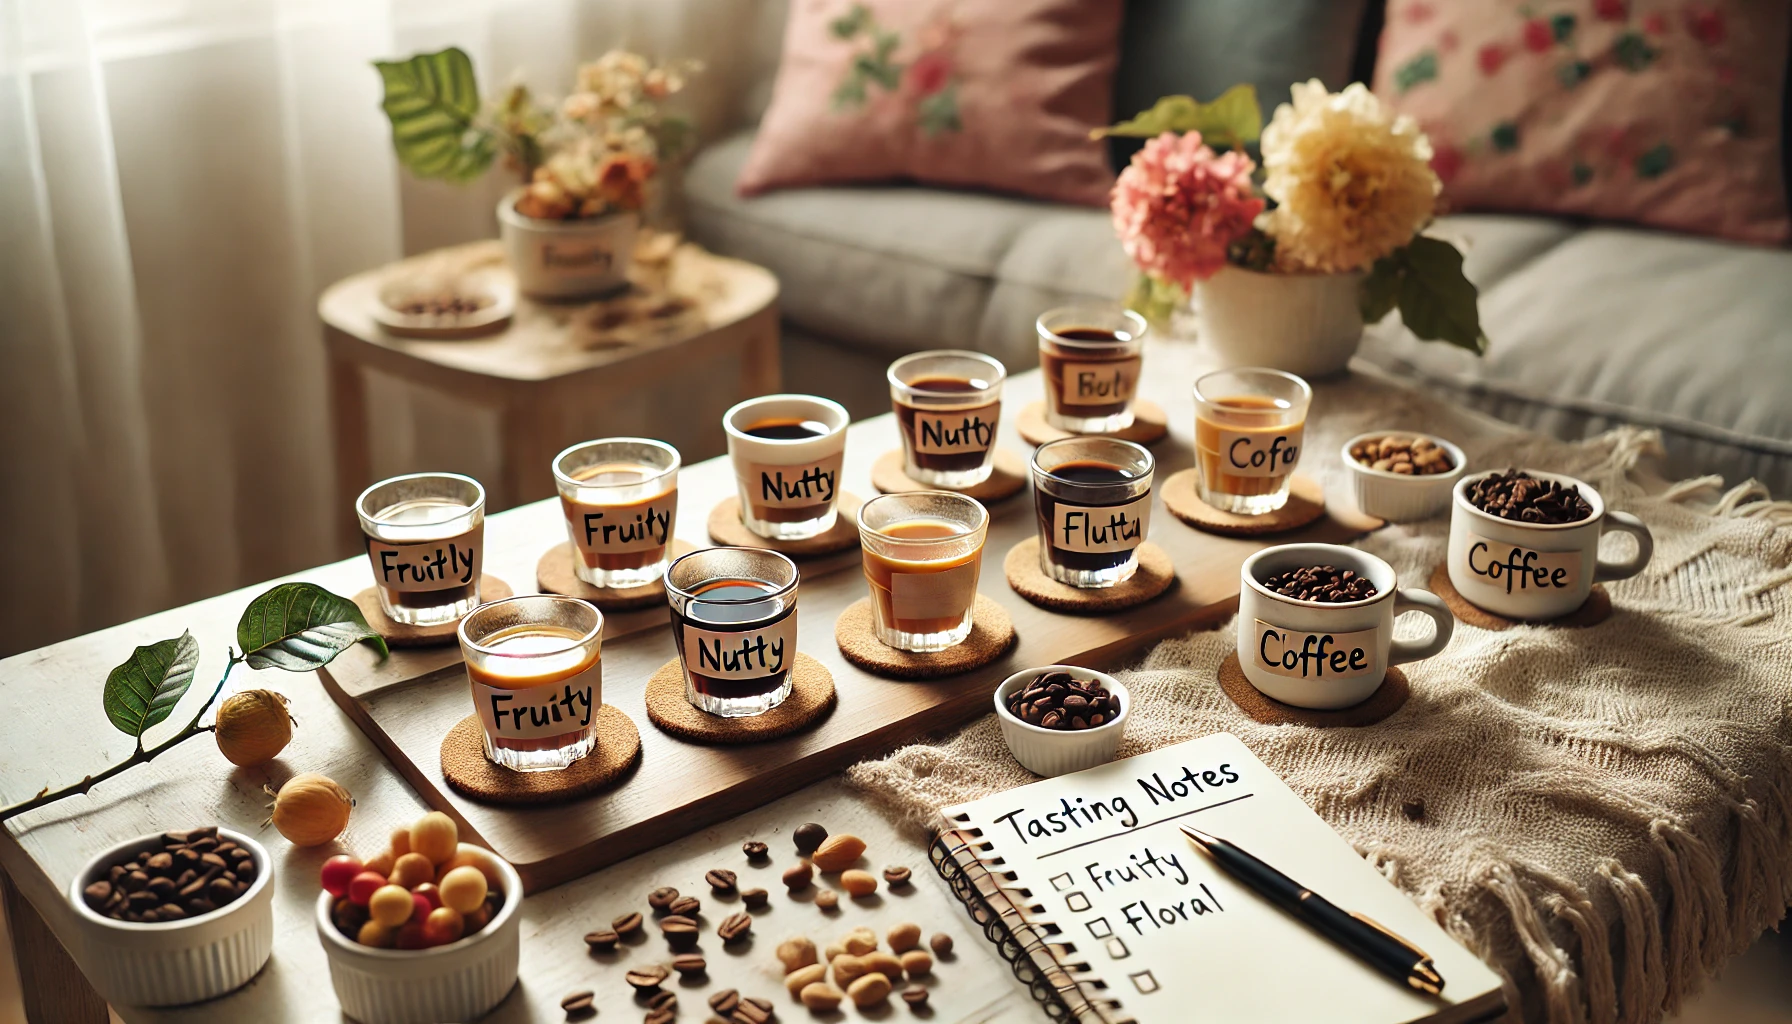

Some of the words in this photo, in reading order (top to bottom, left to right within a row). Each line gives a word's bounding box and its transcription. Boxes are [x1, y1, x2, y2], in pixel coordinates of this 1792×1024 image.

[921, 416, 995, 448] Nutty
[761, 467, 835, 502] Nutty
[584, 507, 670, 546] Fruity
[380, 543, 474, 583] Fruitly
[1469, 542, 1568, 594] Coffee
[698, 635, 784, 673] Nutty
[1260, 629, 1368, 677] Coffee
[490, 685, 592, 730] Fruity
[993, 796, 1139, 844] Tasting
[1137, 763, 1239, 806] Notes
[1085, 847, 1189, 892] Fruity
[1120, 883, 1224, 936] Floral
